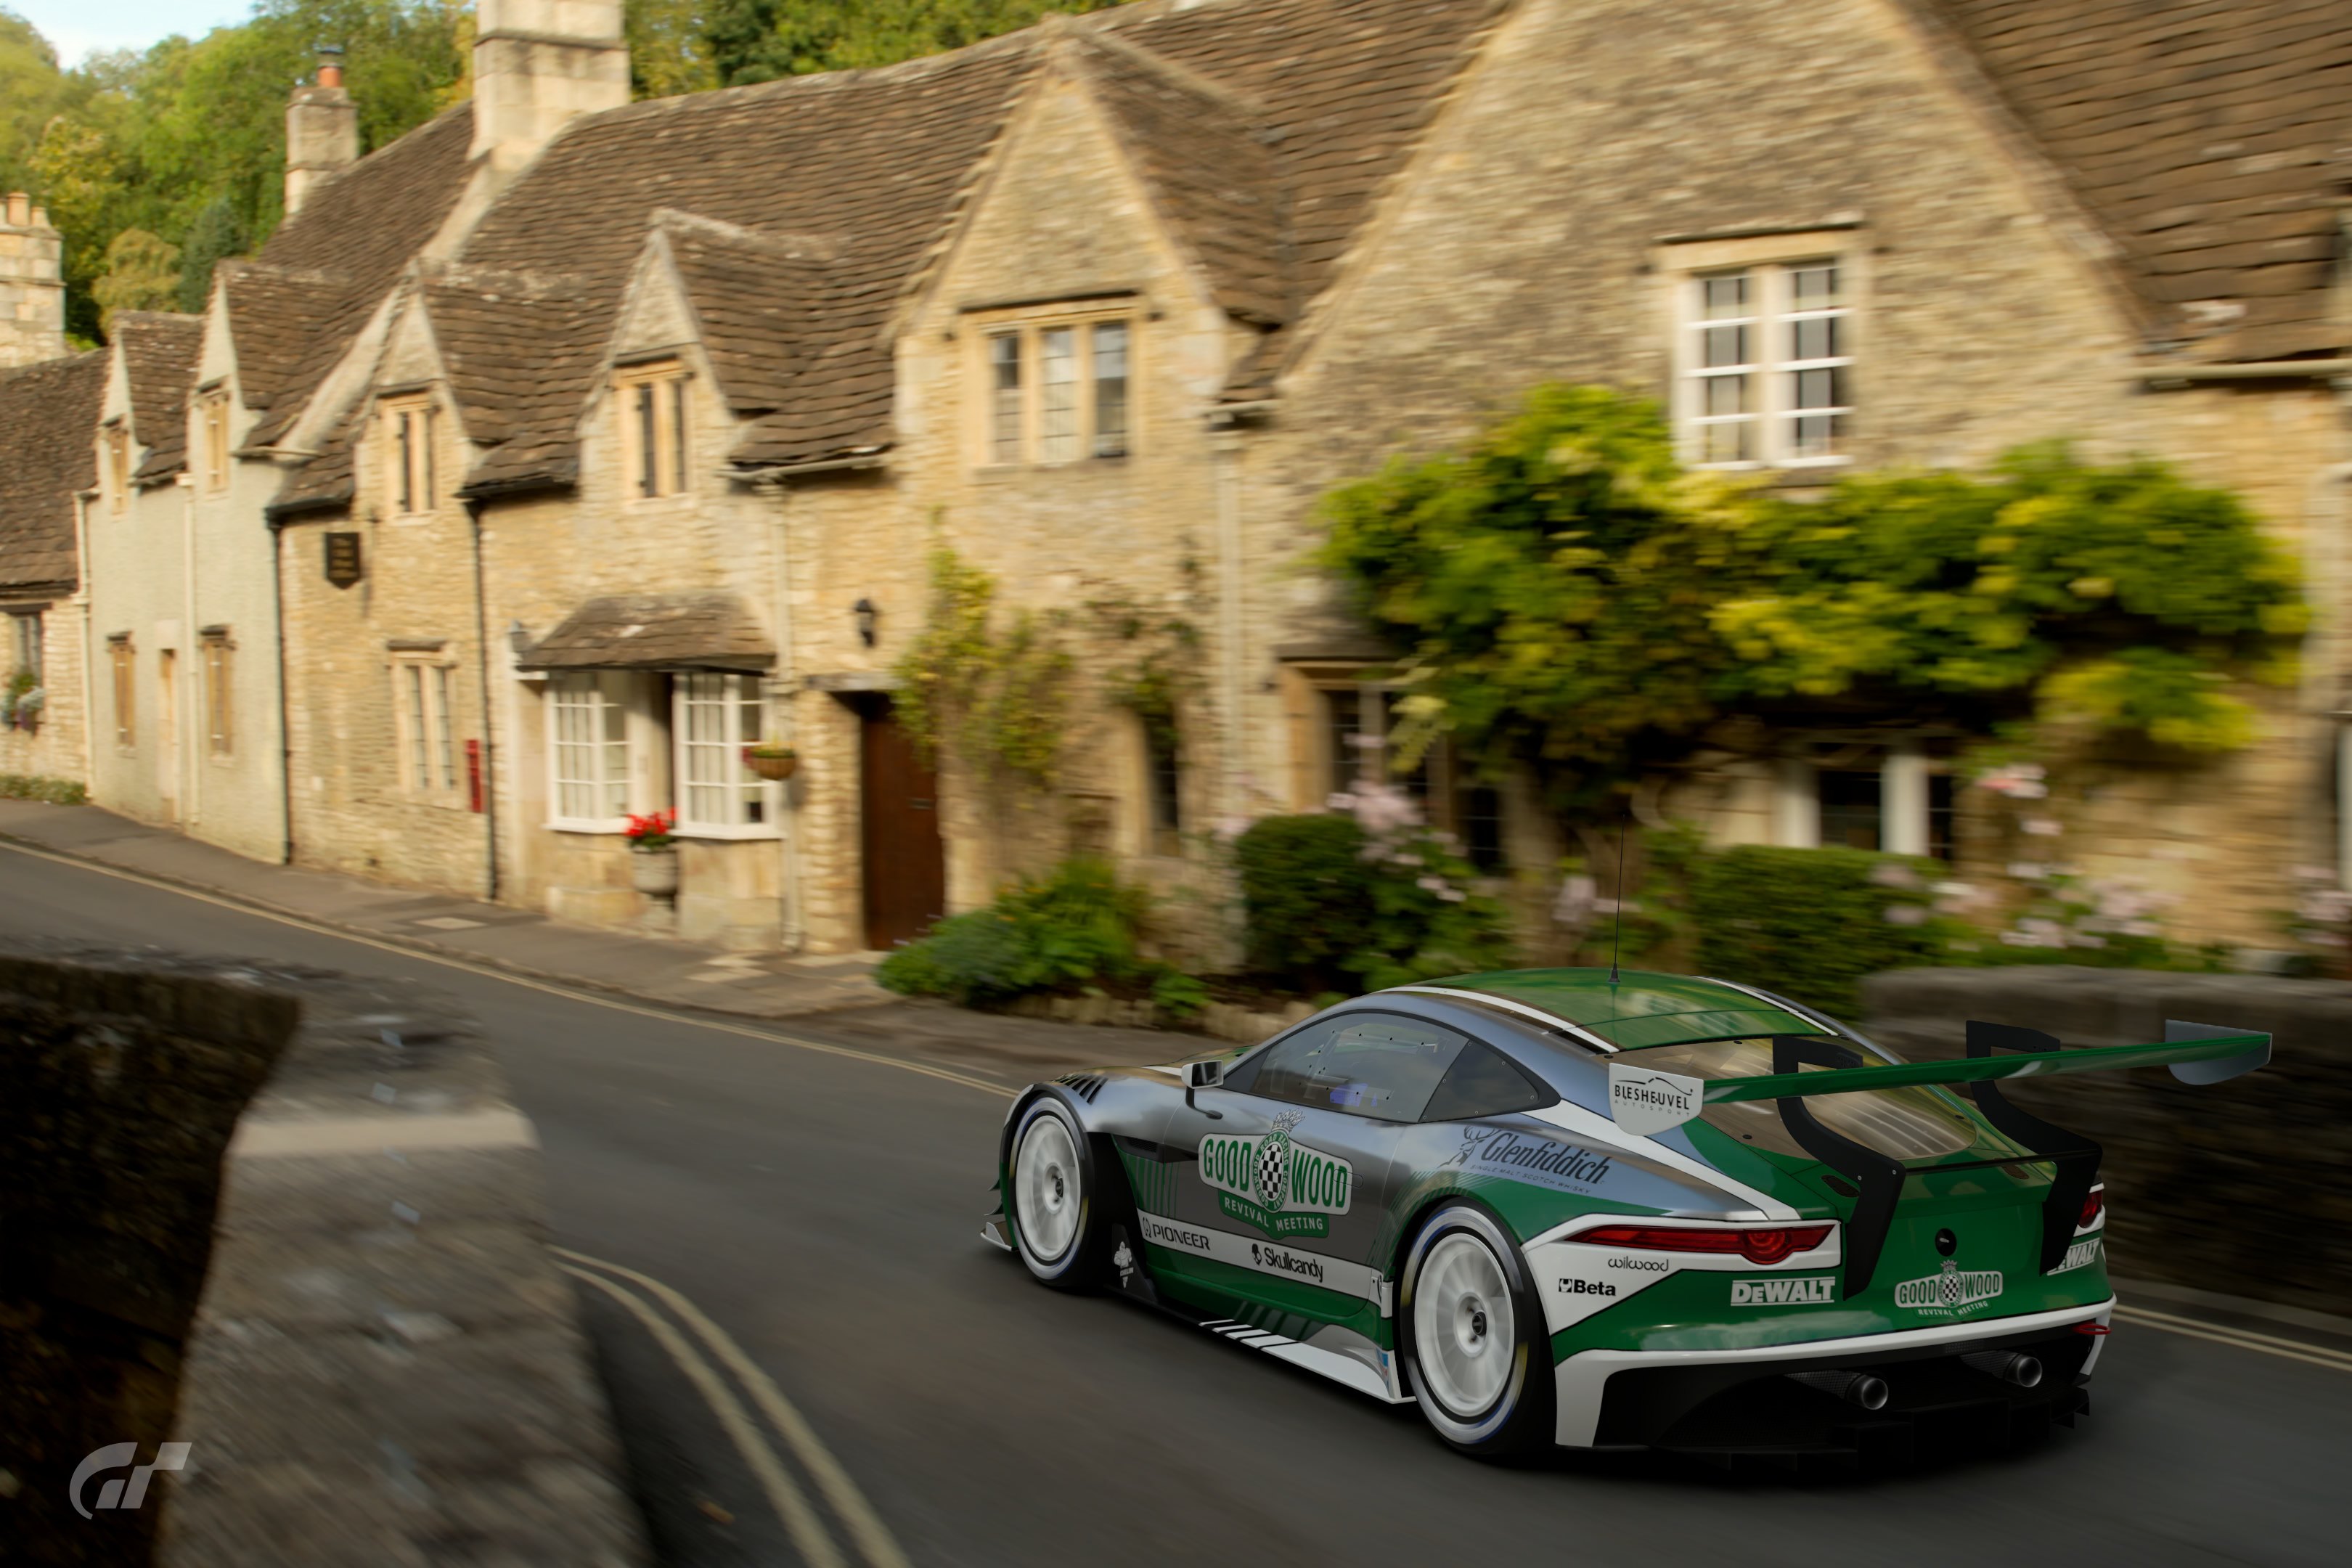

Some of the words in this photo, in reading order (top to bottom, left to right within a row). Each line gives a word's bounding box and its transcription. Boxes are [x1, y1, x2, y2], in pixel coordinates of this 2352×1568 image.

[1614, 1085, 1689, 1110] BLESHEUVEL
[1260, 1133, 1278, 1152] ROAD
[1480, 1132, 1613, 1185] Glenfiddich
[1204, 1138, 1251, 1192] GOOD
[1291, 1149, 1348, 1208] WOOD
[1522, 1173, 1555, 1185] SCOTCH
[1557, 1182, 1591, 1194] WHISKY
[1225, 1196, 1270, 1228] REVIVAL
[1275, 1217, 1323, 1232] MEETING
[1152, 1224, 1210, 1250] PIONEER
[1264, 1247, 1323, 1283] Skullcandy
[1608, 1256, 1669, 1272] wilwood
[2047, 1240, 2099, 1273] EWALT
[1574, 1279, 1616, 1297] Beta
[1900, 1279, 1937, 1304] GOOD
[1964, 1274, 2000, 1299] WOOD
[1957, 1300, 1989, 1315] MEETING
